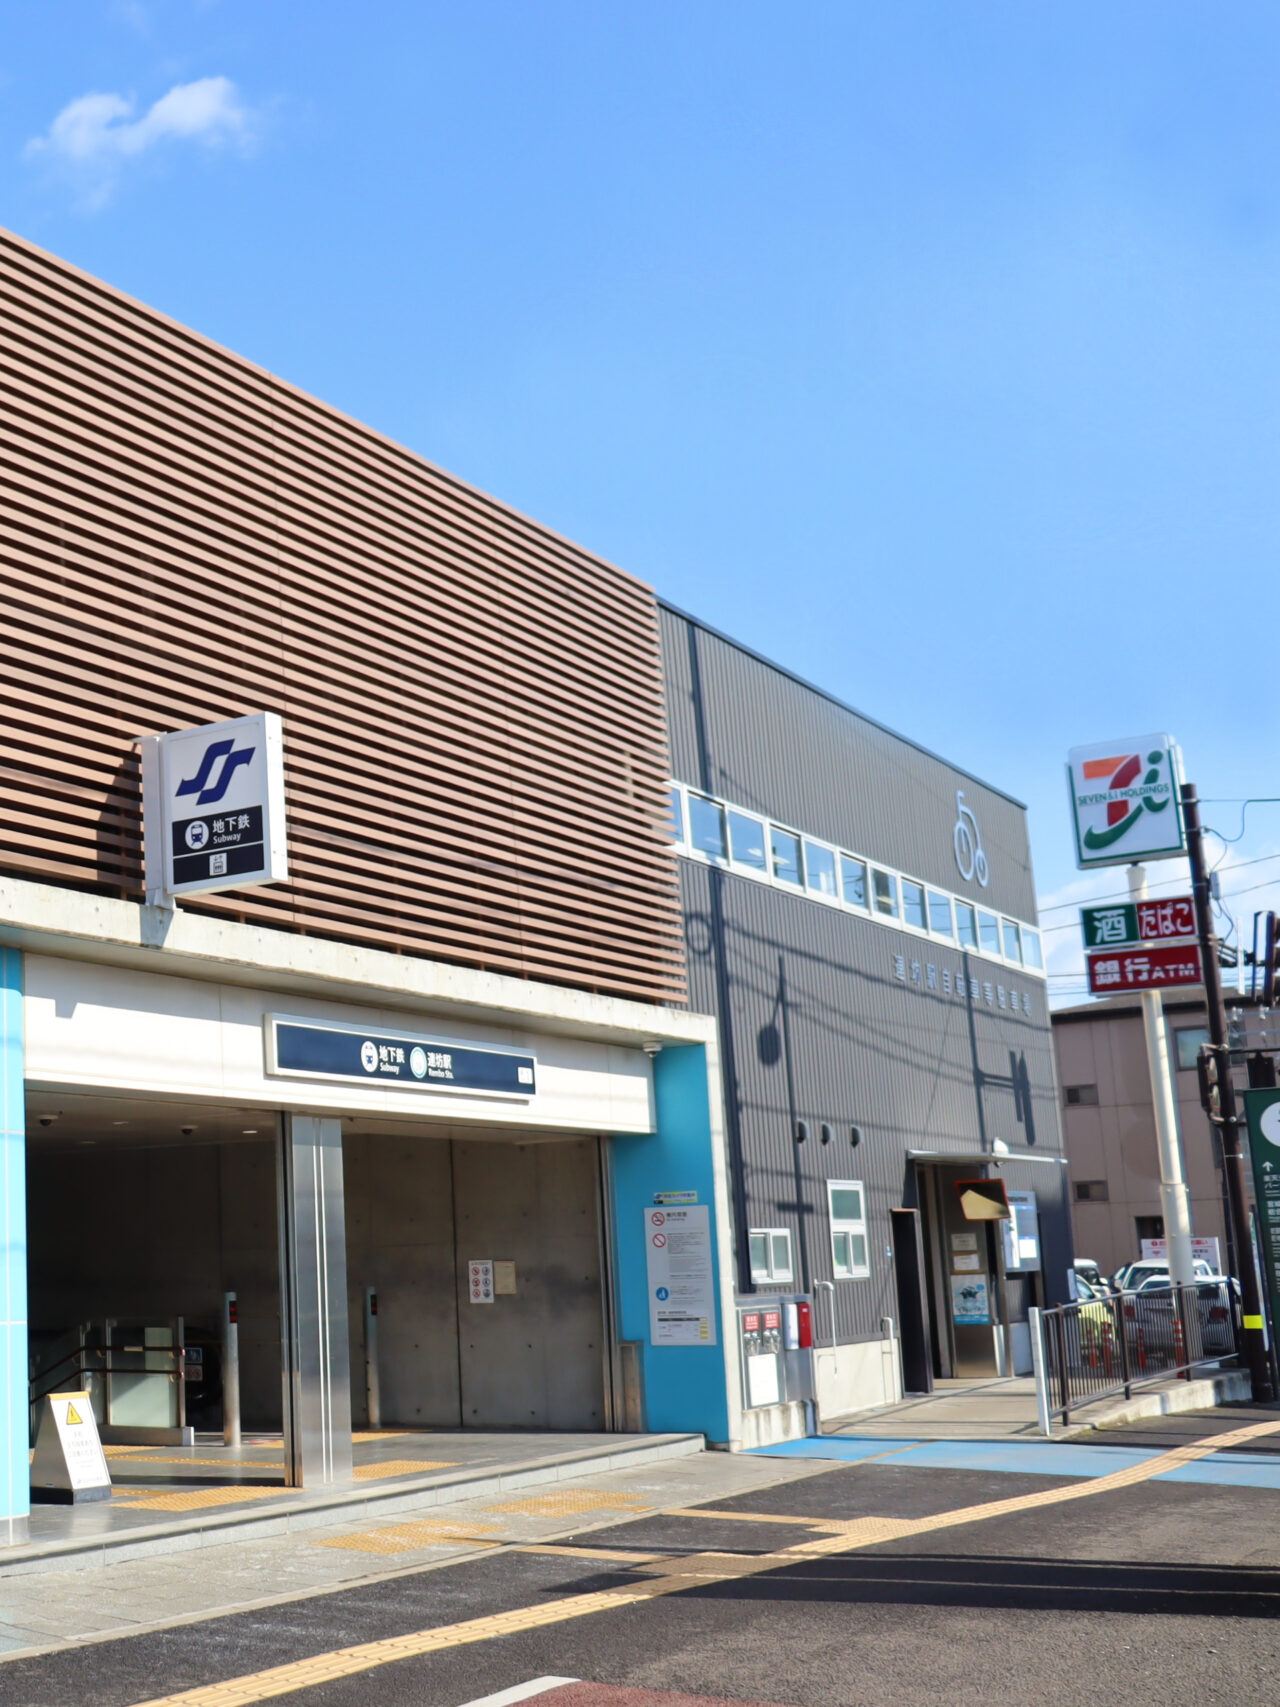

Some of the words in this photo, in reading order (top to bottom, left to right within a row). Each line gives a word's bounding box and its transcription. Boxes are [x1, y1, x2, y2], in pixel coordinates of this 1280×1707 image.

[1120, 783, 1170, 798] HOLDINGS
[212, 814, 250, 834] 地下鉄
[213, 832, 241, 844] Subway
[1093, 909, 1127, 944] 酒
[1139, 903, 1194, 937] たばこ
[379, 1045, 405, 1064] 地下鉄
[427, 1051, 452, 1070] 連坊駅
[379, 1063, 400, 1075] Subway
